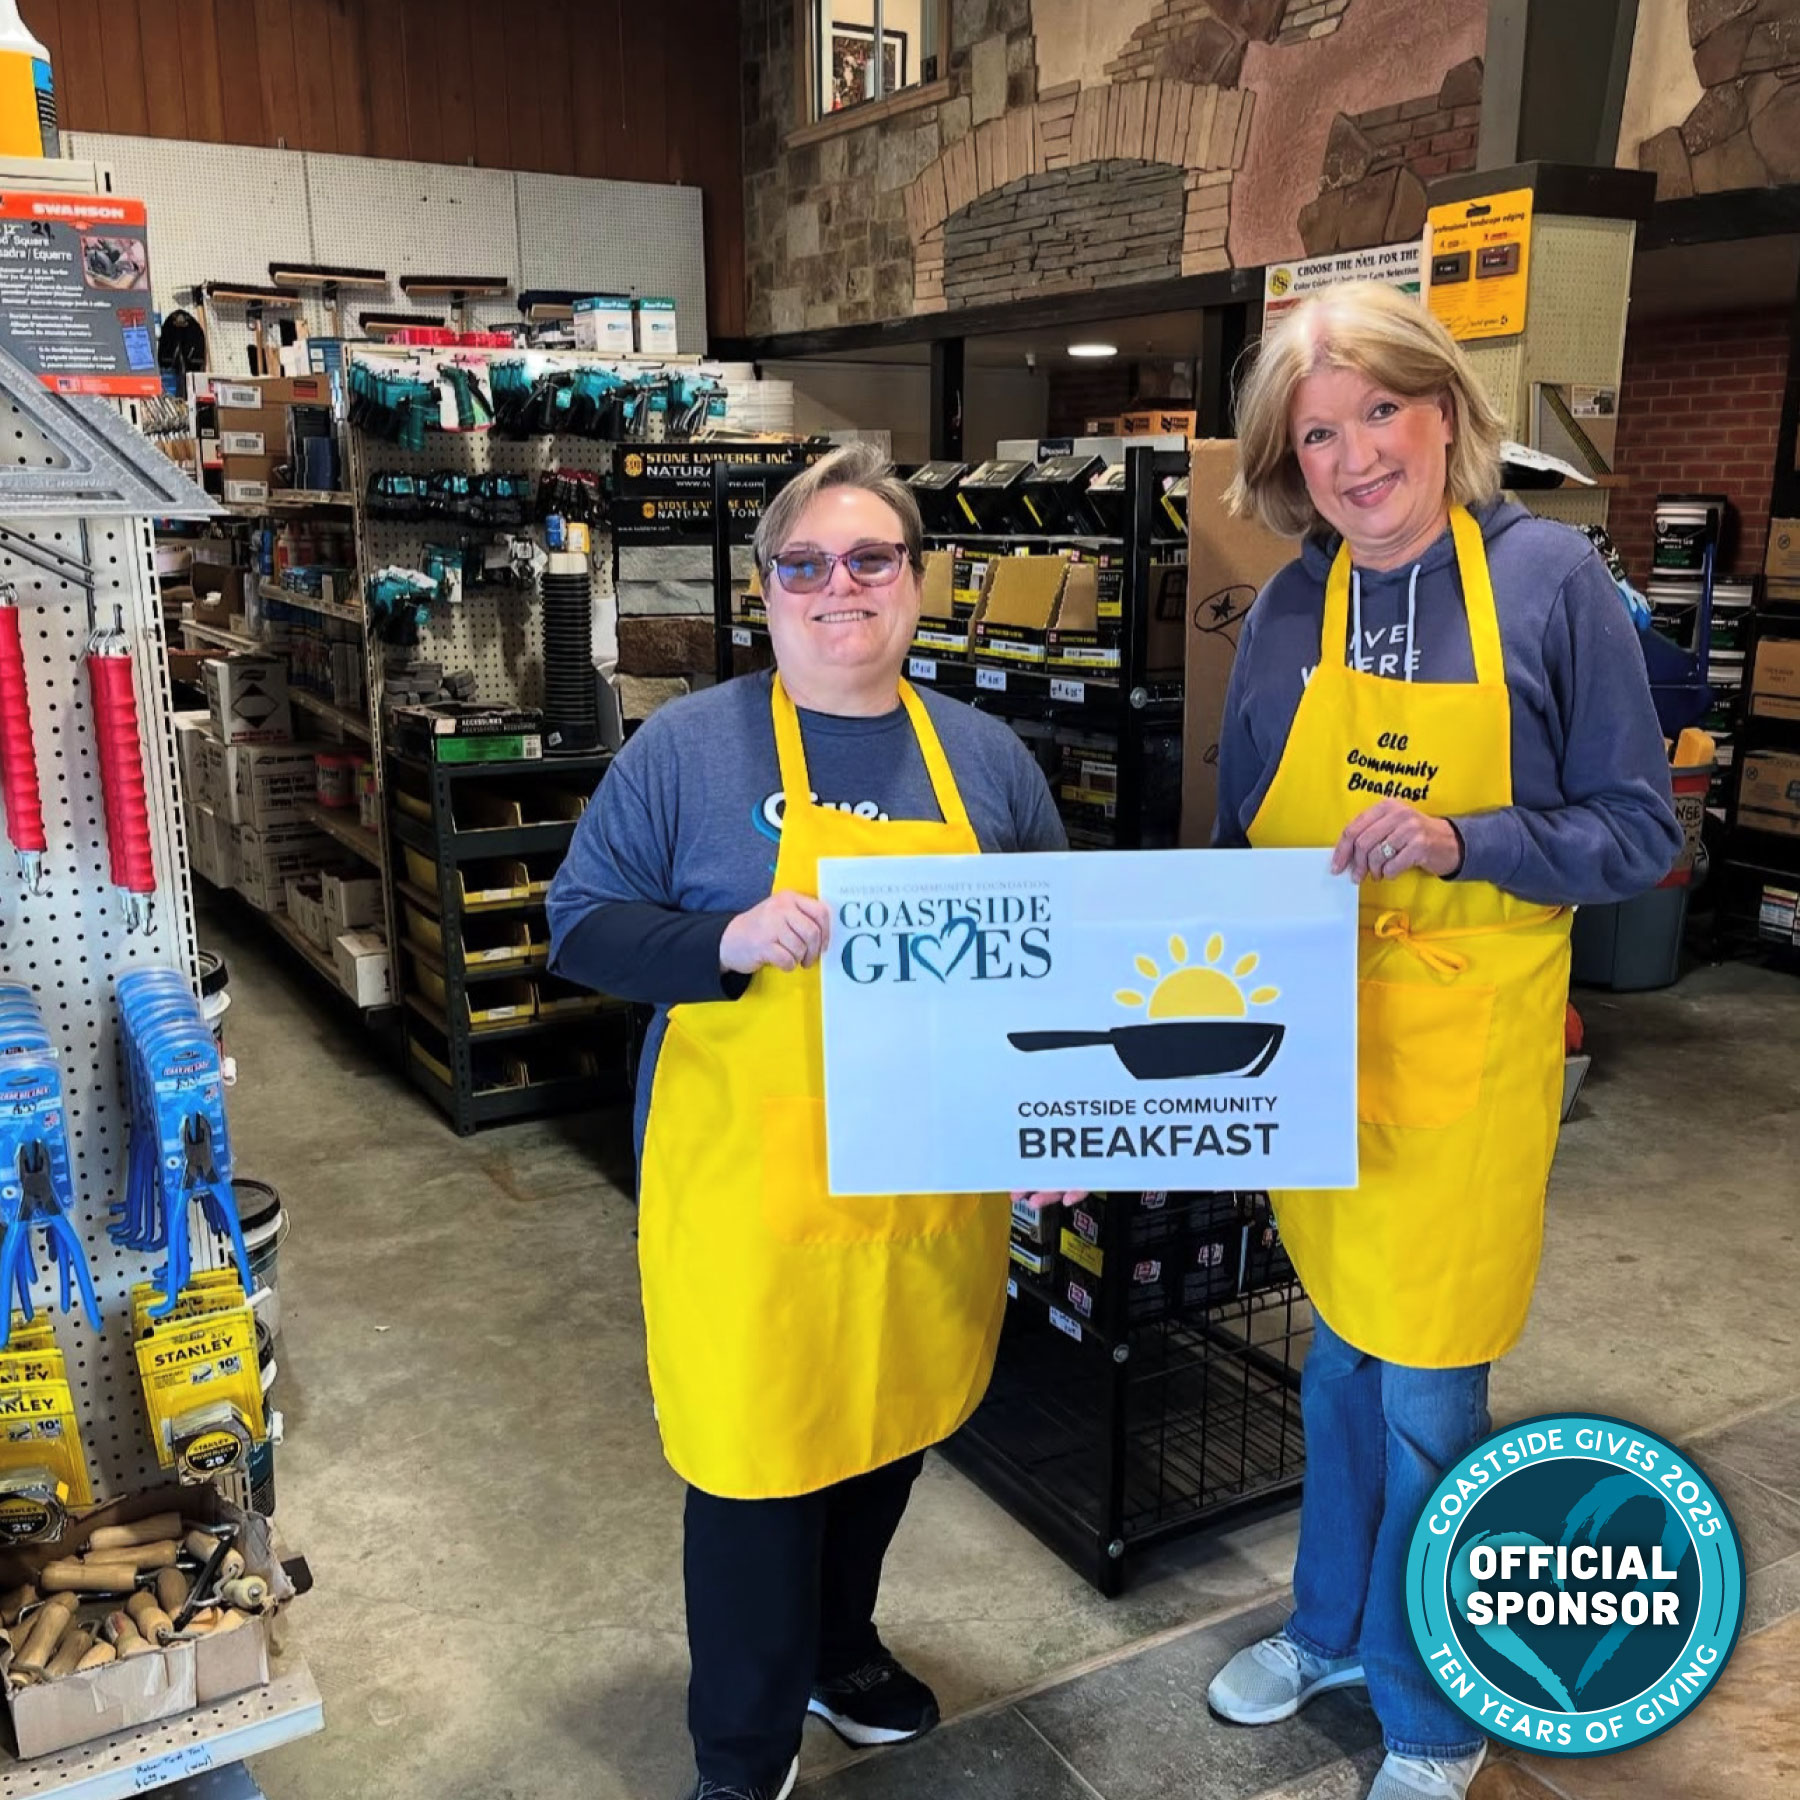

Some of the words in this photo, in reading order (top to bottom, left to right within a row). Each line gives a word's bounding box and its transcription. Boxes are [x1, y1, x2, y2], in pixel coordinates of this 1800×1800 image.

[32, 202, 125, 219] SWANSON
[1297, 261, 1333, 277] CHOOSE
[1336, 258, 1353, 271] THE
[1379, 251, 1397, 265] FOR
[1401, 248, 1419, 261] THE
[646, 453, 687, 464] STONE
[693, 453, 760, 465] UNIVERSE
[1377, 732, 1409, 751] CLC
[1347, 749, 1439, 781] Community
[1348, 772, 1430, 802] Breakfast
[902, 881, 974, 893] COMMUNITY
[975, 879, 1051, 890] FOUNDATION
[839, 894, 1052, 929] COASTSIDE
[1017, 1100, 1137, 1118] COASTSIDE
[1143, 1096, 1278, 1116] COMMUNITY
[1019, 1123, 1280, 1159] BREAKFAST
[154, 1336, 233, 1367] STANLEY
[205, 1453, 228, 1468] 25'
[12, 1522, 35, 1533] 25'
